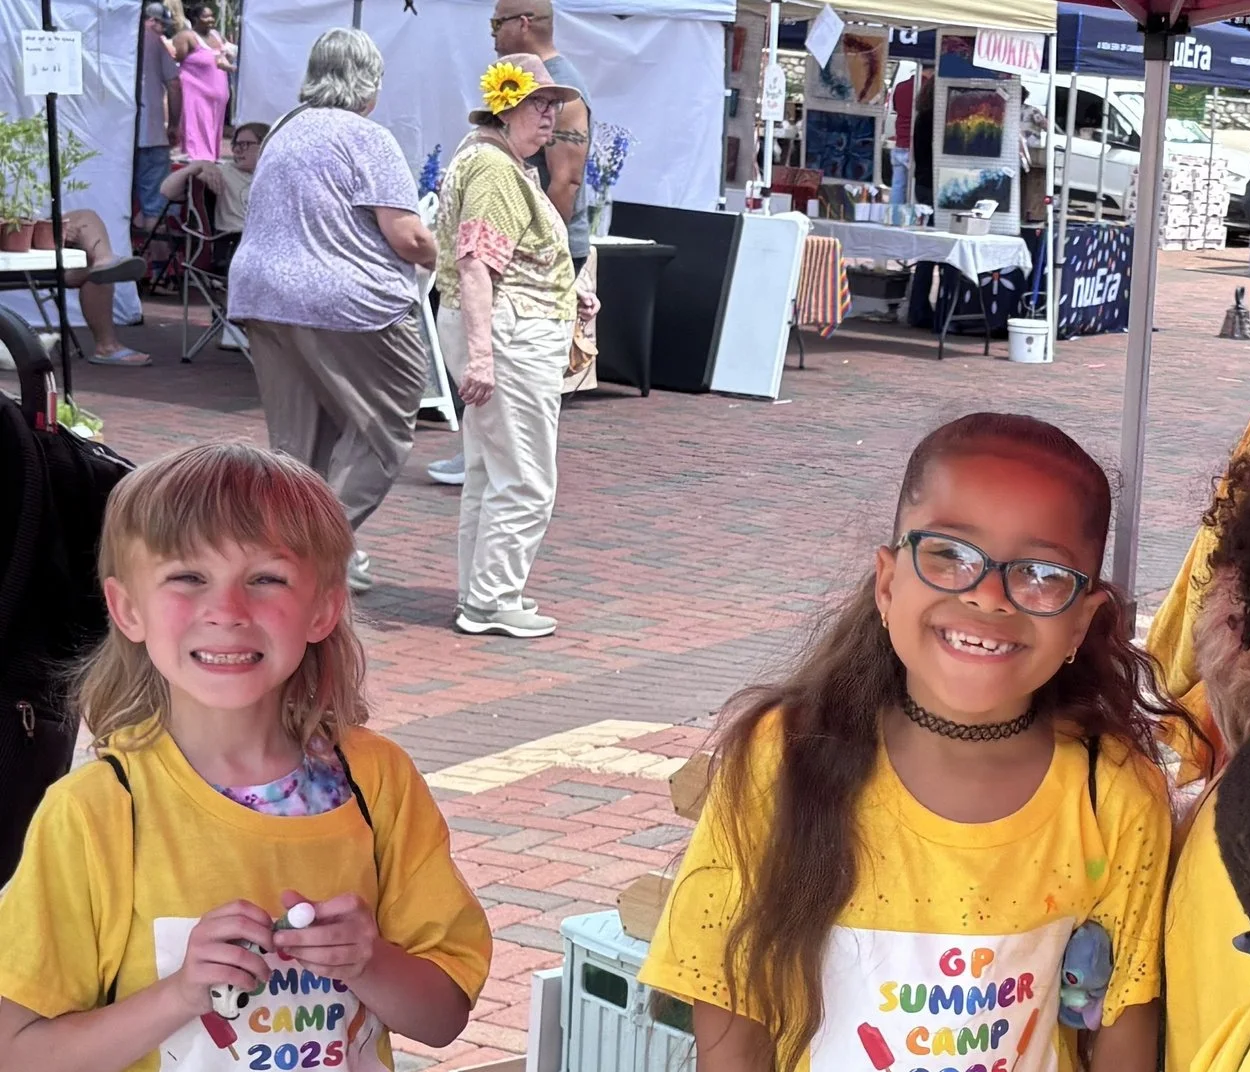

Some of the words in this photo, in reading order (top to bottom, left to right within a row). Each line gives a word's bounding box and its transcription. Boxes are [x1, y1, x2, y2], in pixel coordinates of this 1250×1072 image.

[977, 30, 1041, 71] COOKIES
[1170, 36, 1212, 71] uEra
[1071, 267, 1121, 308] nuEra
[248, 1002, 346, 1034] CAMP
[905, 1018, 1010, 1056] CAMP
[247, 1040, 344, 1072] 2025
